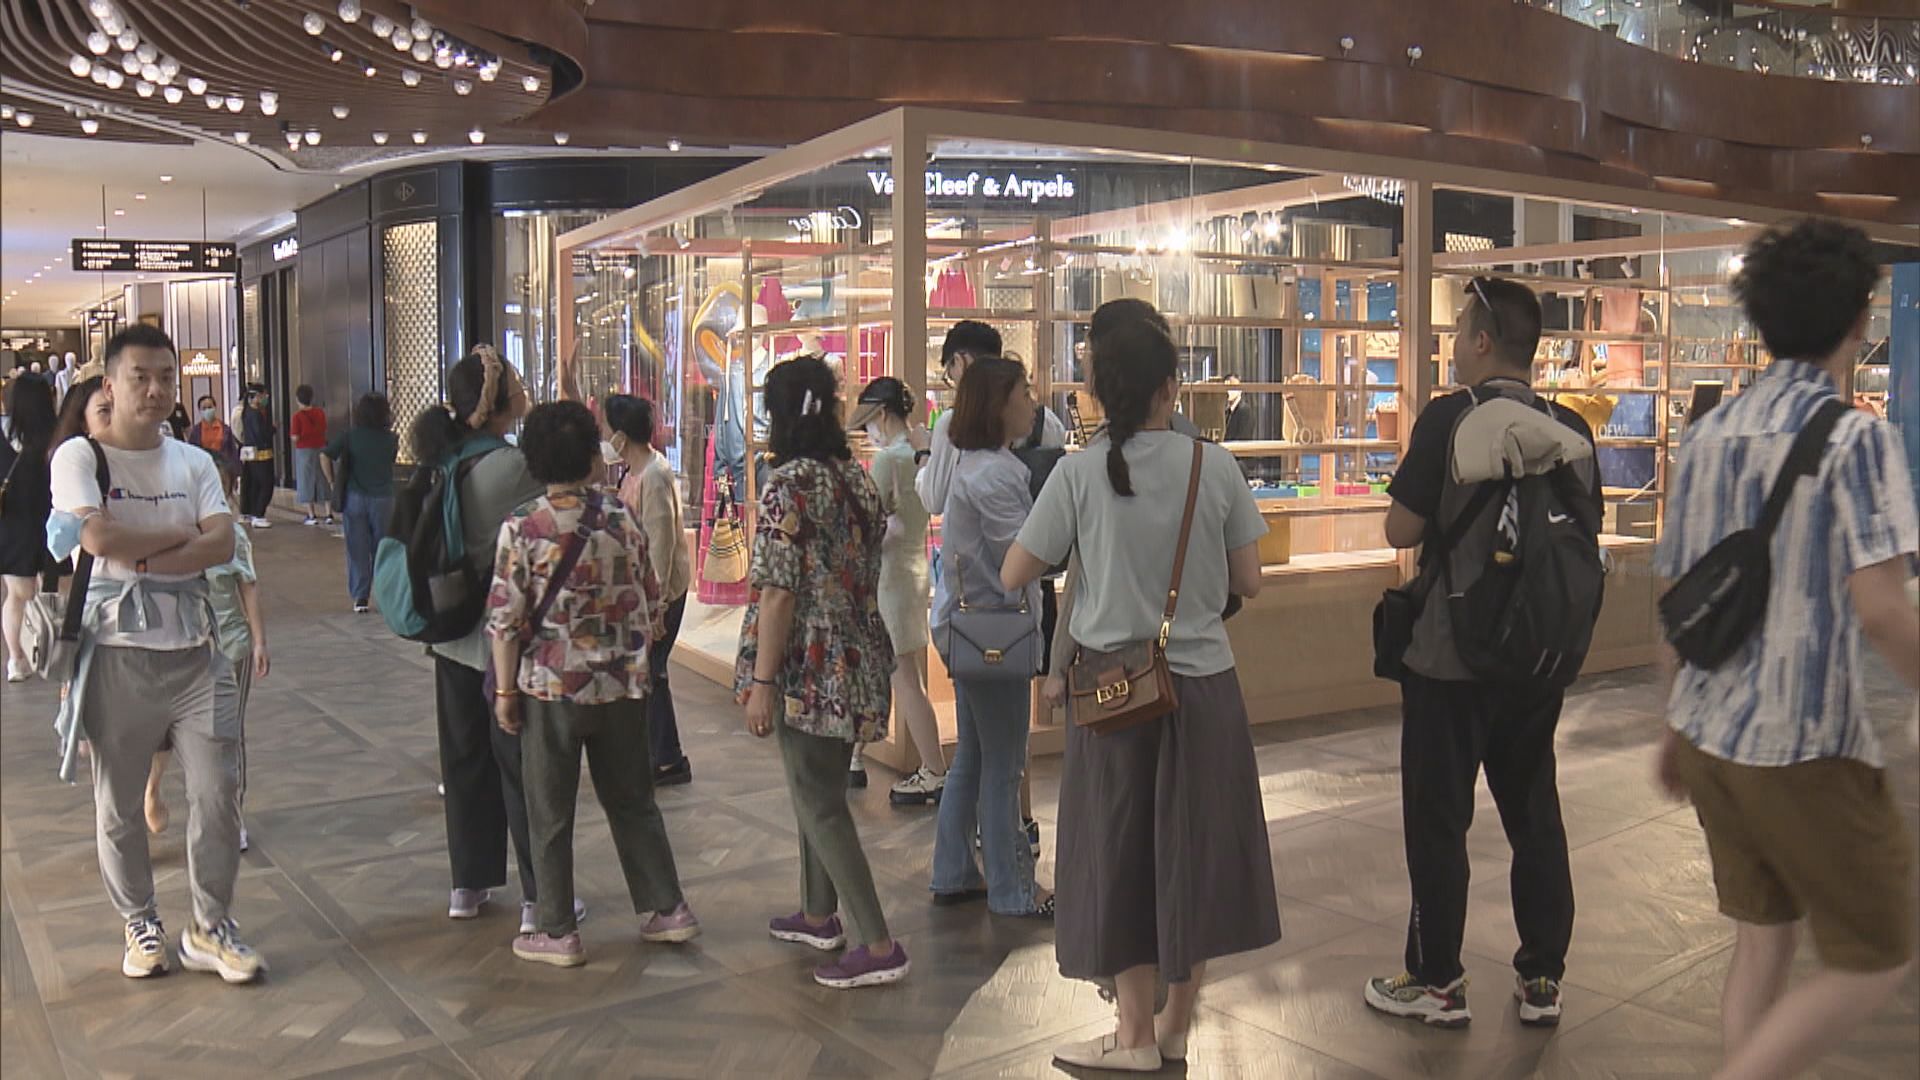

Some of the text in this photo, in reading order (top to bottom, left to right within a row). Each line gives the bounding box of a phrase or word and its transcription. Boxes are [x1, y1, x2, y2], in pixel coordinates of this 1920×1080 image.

[867, 171, 894, 196] Va
[982, 176, 1000, 197] &
[1003, 173, 1074, 203] Arpels
